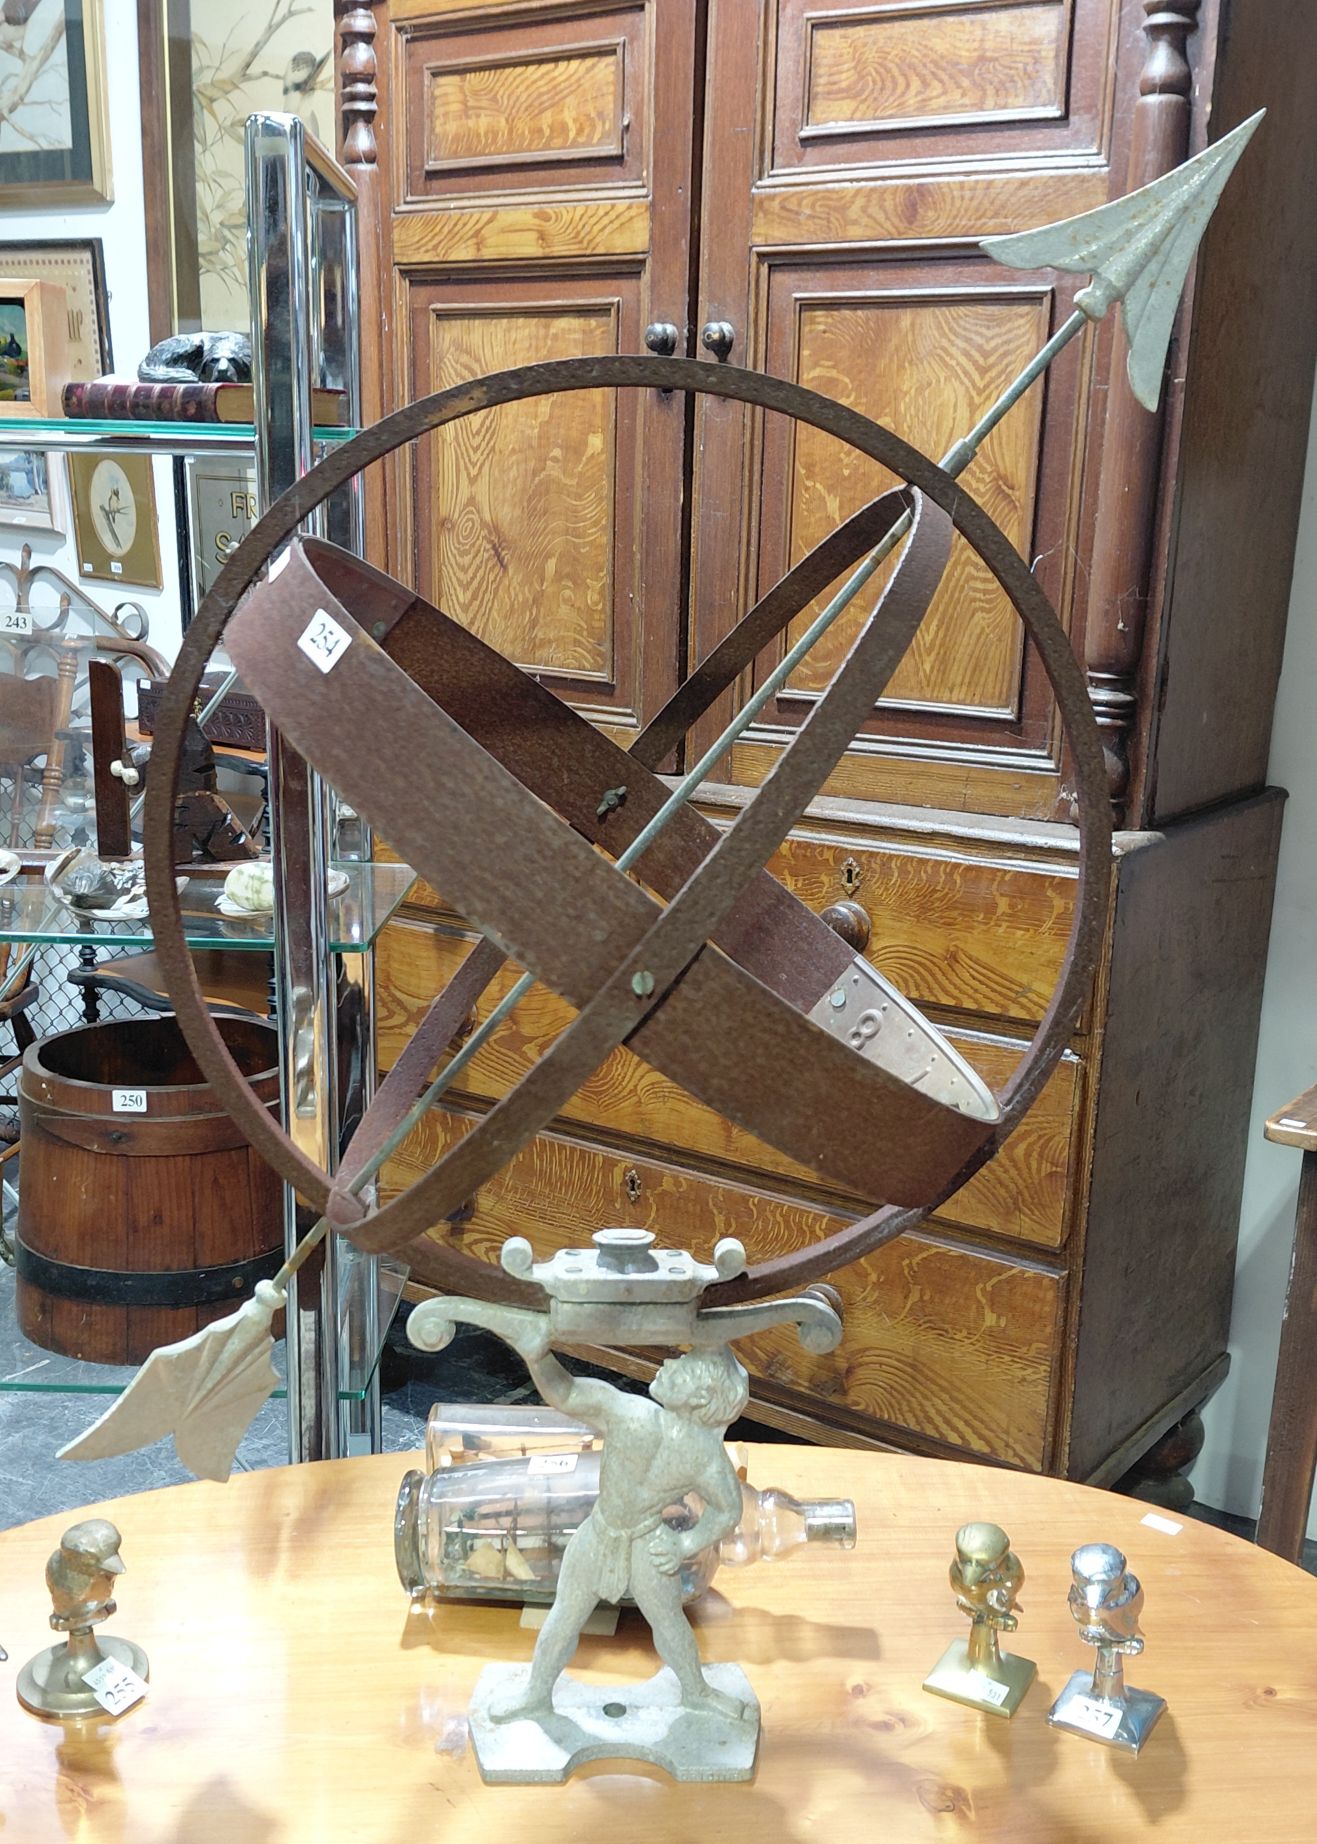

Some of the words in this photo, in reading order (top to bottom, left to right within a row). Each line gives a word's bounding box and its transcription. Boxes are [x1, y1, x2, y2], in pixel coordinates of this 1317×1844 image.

[5, 615, 28, 630] 243
[310, 622, 341, 658] 254
[120, 1094, 143, 1107] 250
[104, 1676, 137, 1706] 255
